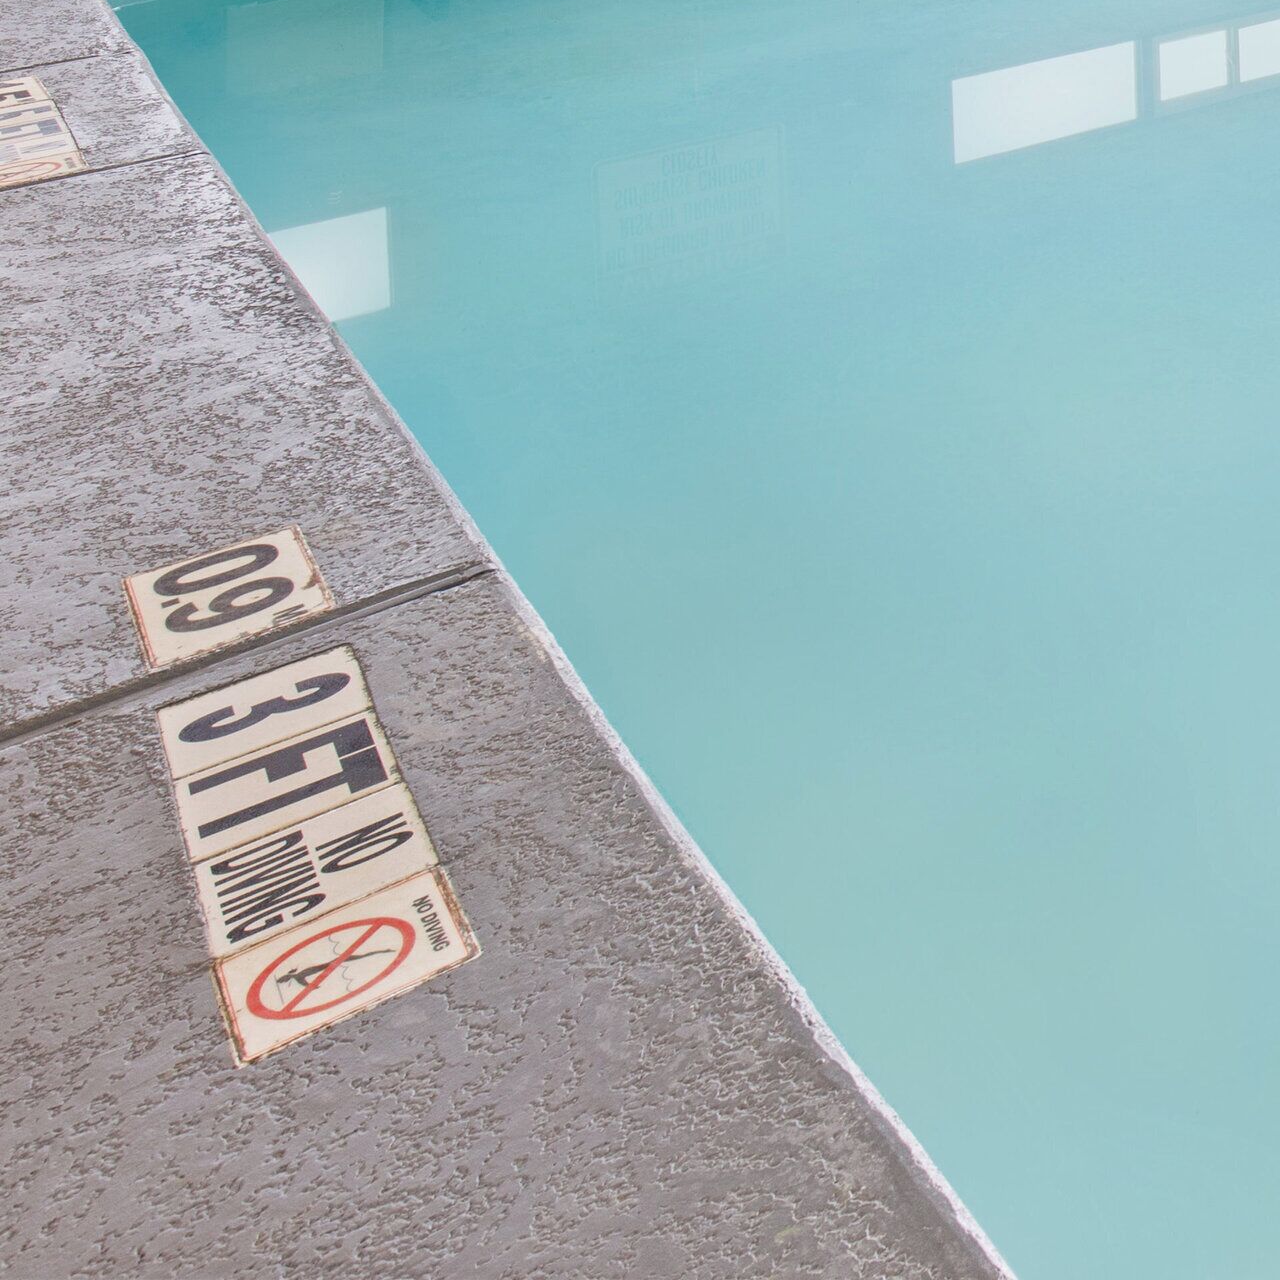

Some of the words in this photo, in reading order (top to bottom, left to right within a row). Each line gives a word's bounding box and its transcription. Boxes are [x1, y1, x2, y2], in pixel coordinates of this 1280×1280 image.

[153, 543, 295, 633] 0.9
[178, 672, 351, 743] 3
[188, 717, 389, 839] FT
[314, 811, 413, 873] NO
[210, 829, 326, 945] DIVING
[411, 895, 434, 914] NO
[420, 912, 450, 951] DIVING
